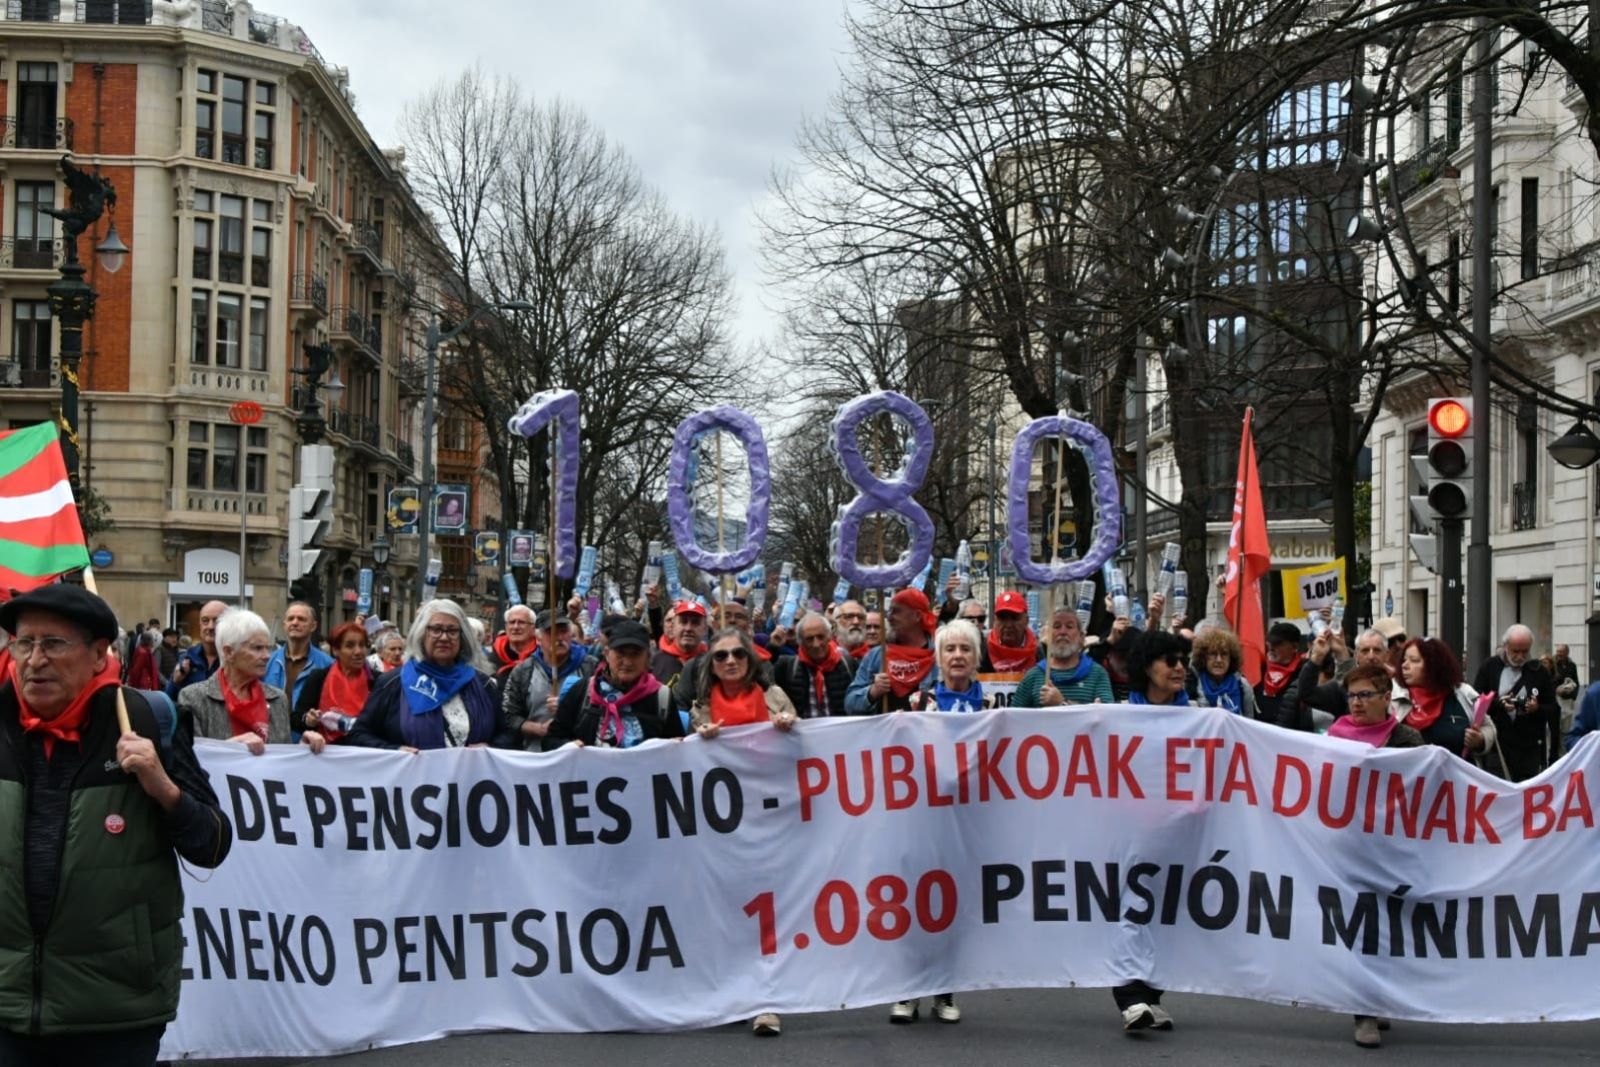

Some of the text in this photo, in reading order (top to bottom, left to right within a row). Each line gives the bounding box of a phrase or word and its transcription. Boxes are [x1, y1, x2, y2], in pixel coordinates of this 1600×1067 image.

[197, 571, 229, 584] TOUS
[1303, 576, 1338, 600] 1.080
[225, 773, 298, 846] DE
[303, 776, 632, 851] PENSIONES
[652, 767, 744, 839] NO
[797, 734, 1144, 822] PUBLIKOAK
[1166, 738, 1258, 806] ETA
[1272, 754, 1502, 844] DUINAK
[353, 905, 686, 985] PENTSIOA
[743, 869, 958, 956] 1.080
[981, 849, 1294, 940] PENSIÓN
